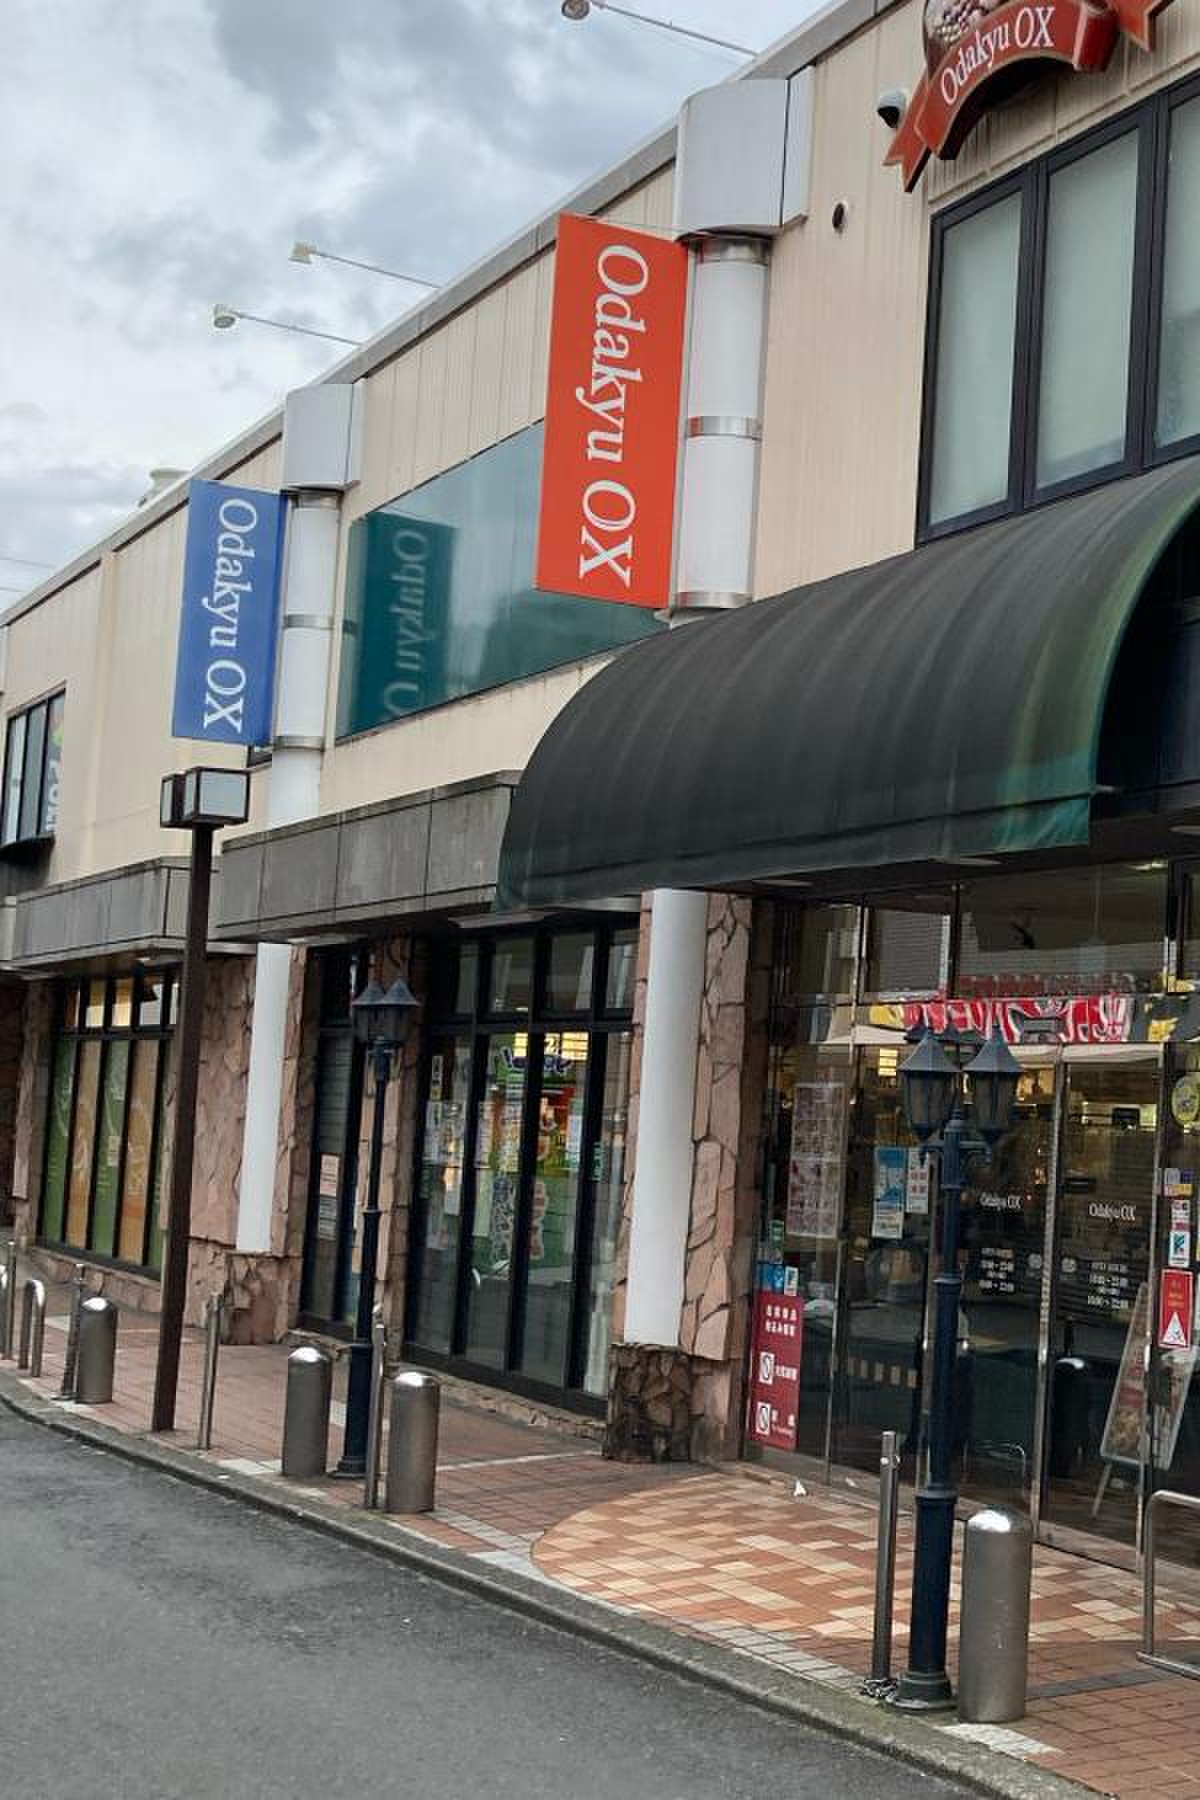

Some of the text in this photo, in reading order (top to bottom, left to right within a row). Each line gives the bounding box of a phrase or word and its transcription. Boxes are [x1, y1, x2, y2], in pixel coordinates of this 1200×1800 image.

[939, 6, 1056, 105] Odakyu OX
[576, 244, 649, 588] Odakyu OX
[201, 498, 257, 734] Odakyu OX
